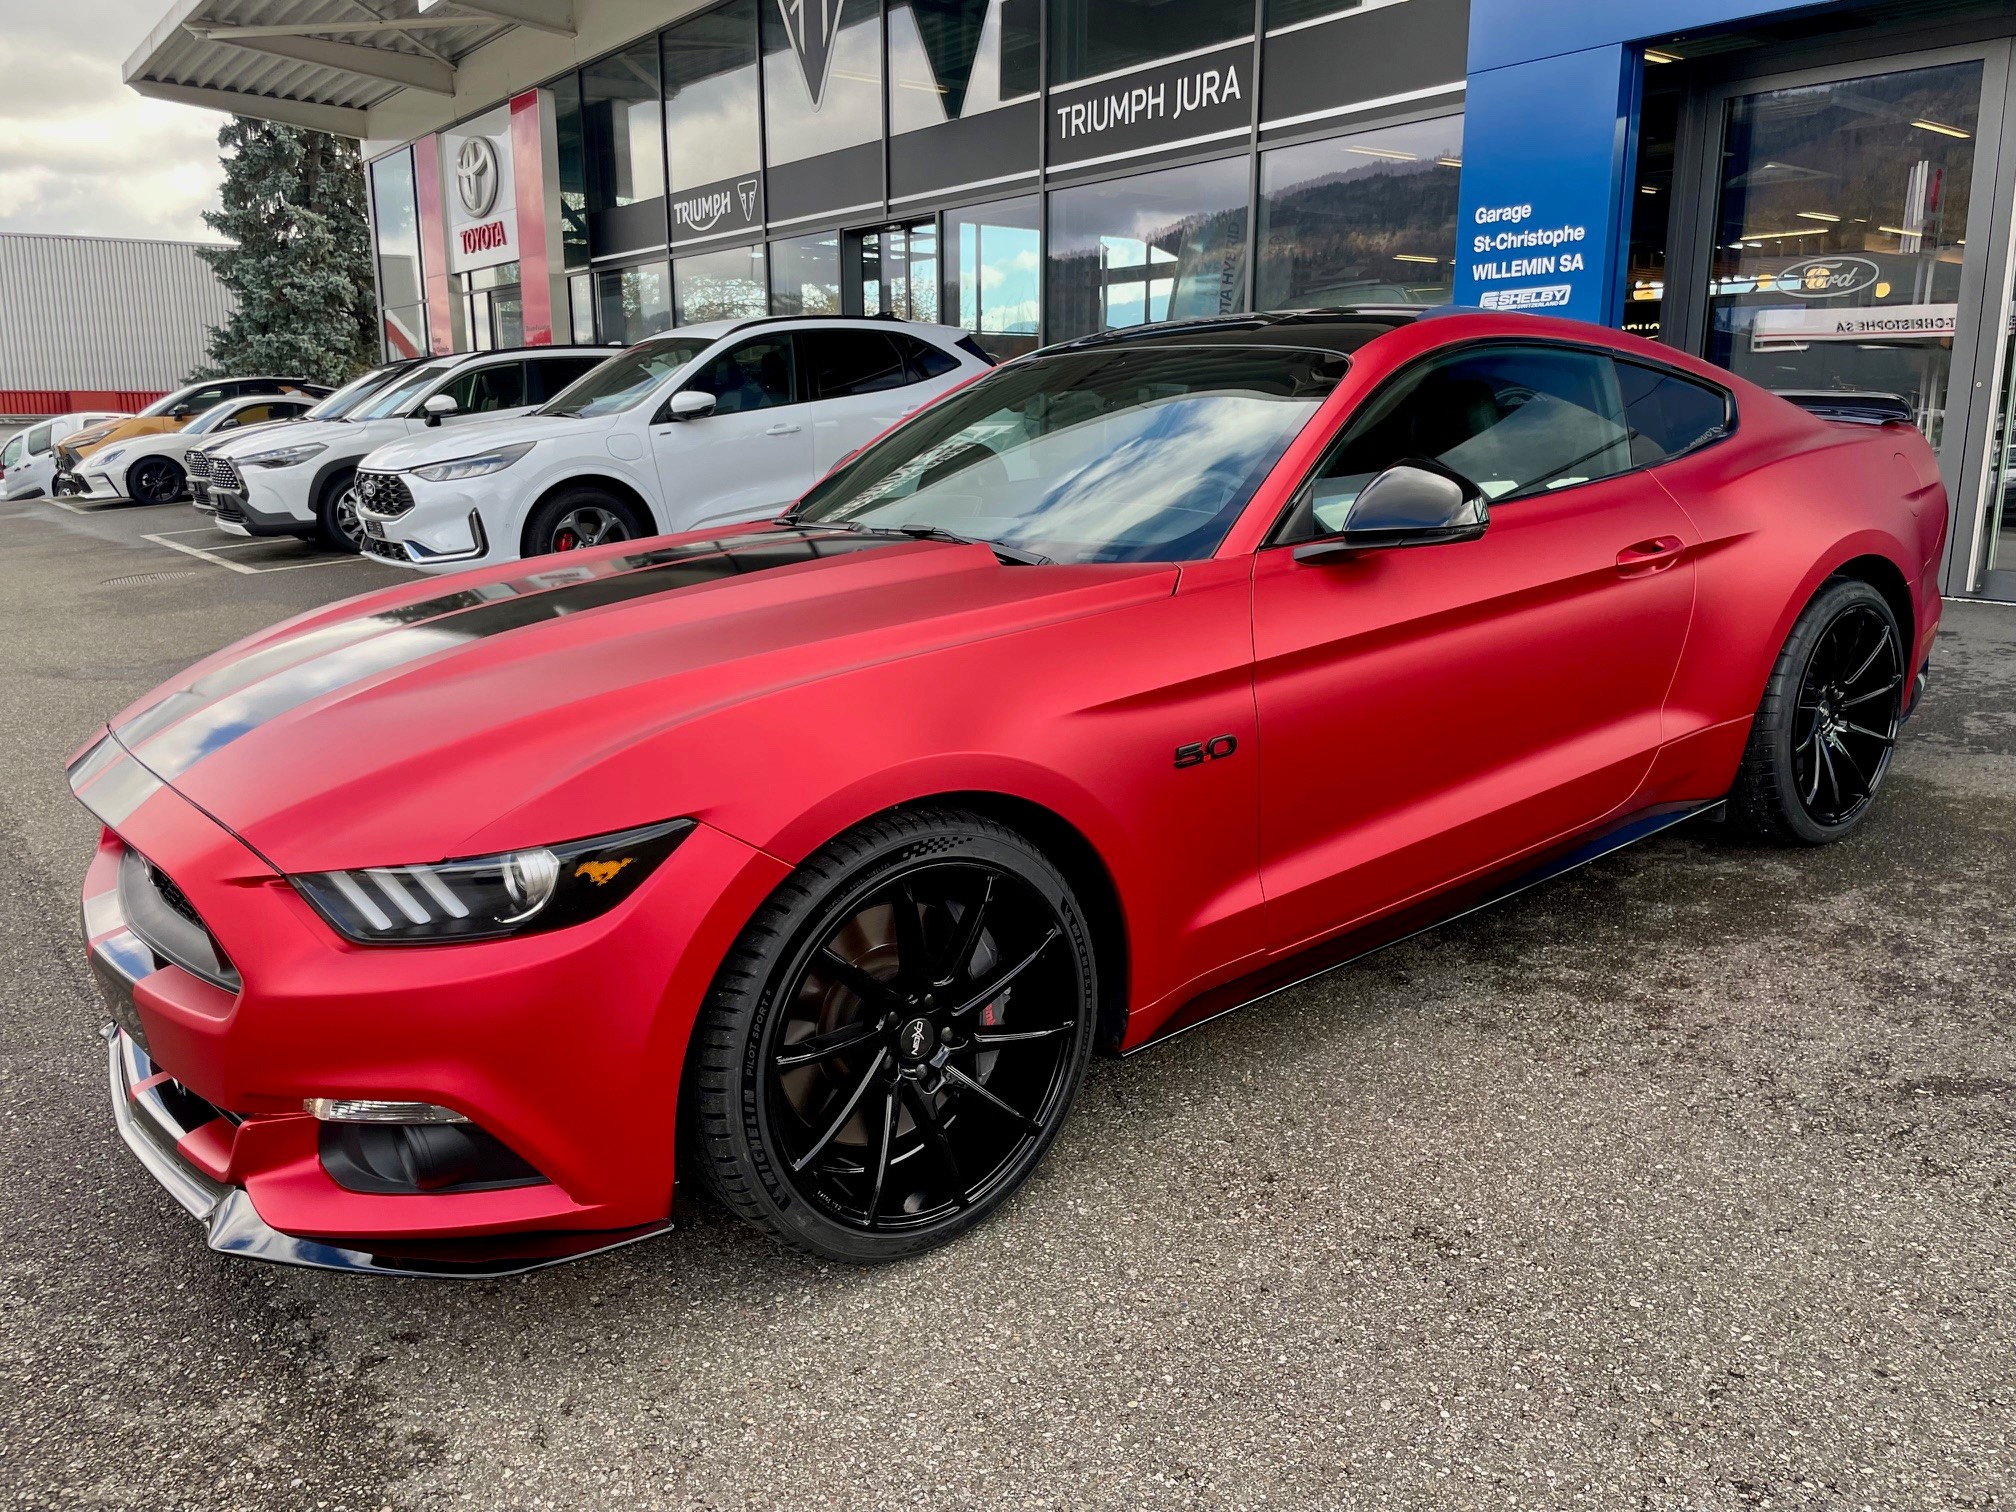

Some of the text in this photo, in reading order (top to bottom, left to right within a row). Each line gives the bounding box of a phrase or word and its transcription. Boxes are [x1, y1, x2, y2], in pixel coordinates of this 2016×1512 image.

[1057, 65, 1242, 139] TRIUMPH JURA
[674, 191, 731, 231] TRIUMPH
[1475, 204, 1532, 224] Garage
[460, 221, 507, 255] TOYOTA
[1473, 225, 1585, 253] St-Christophe
[1472, 254, 1584, 281] WILLEMIN SA
[1798, 262, 1858, 289] Ford
[1498, 290, 1566, 306] SHELBY
[752, 998, 769, 1039] SPORT
[745, 1042, 757, 1076] PILOT
[743, 1088, 777, 1186] MICHELIN
